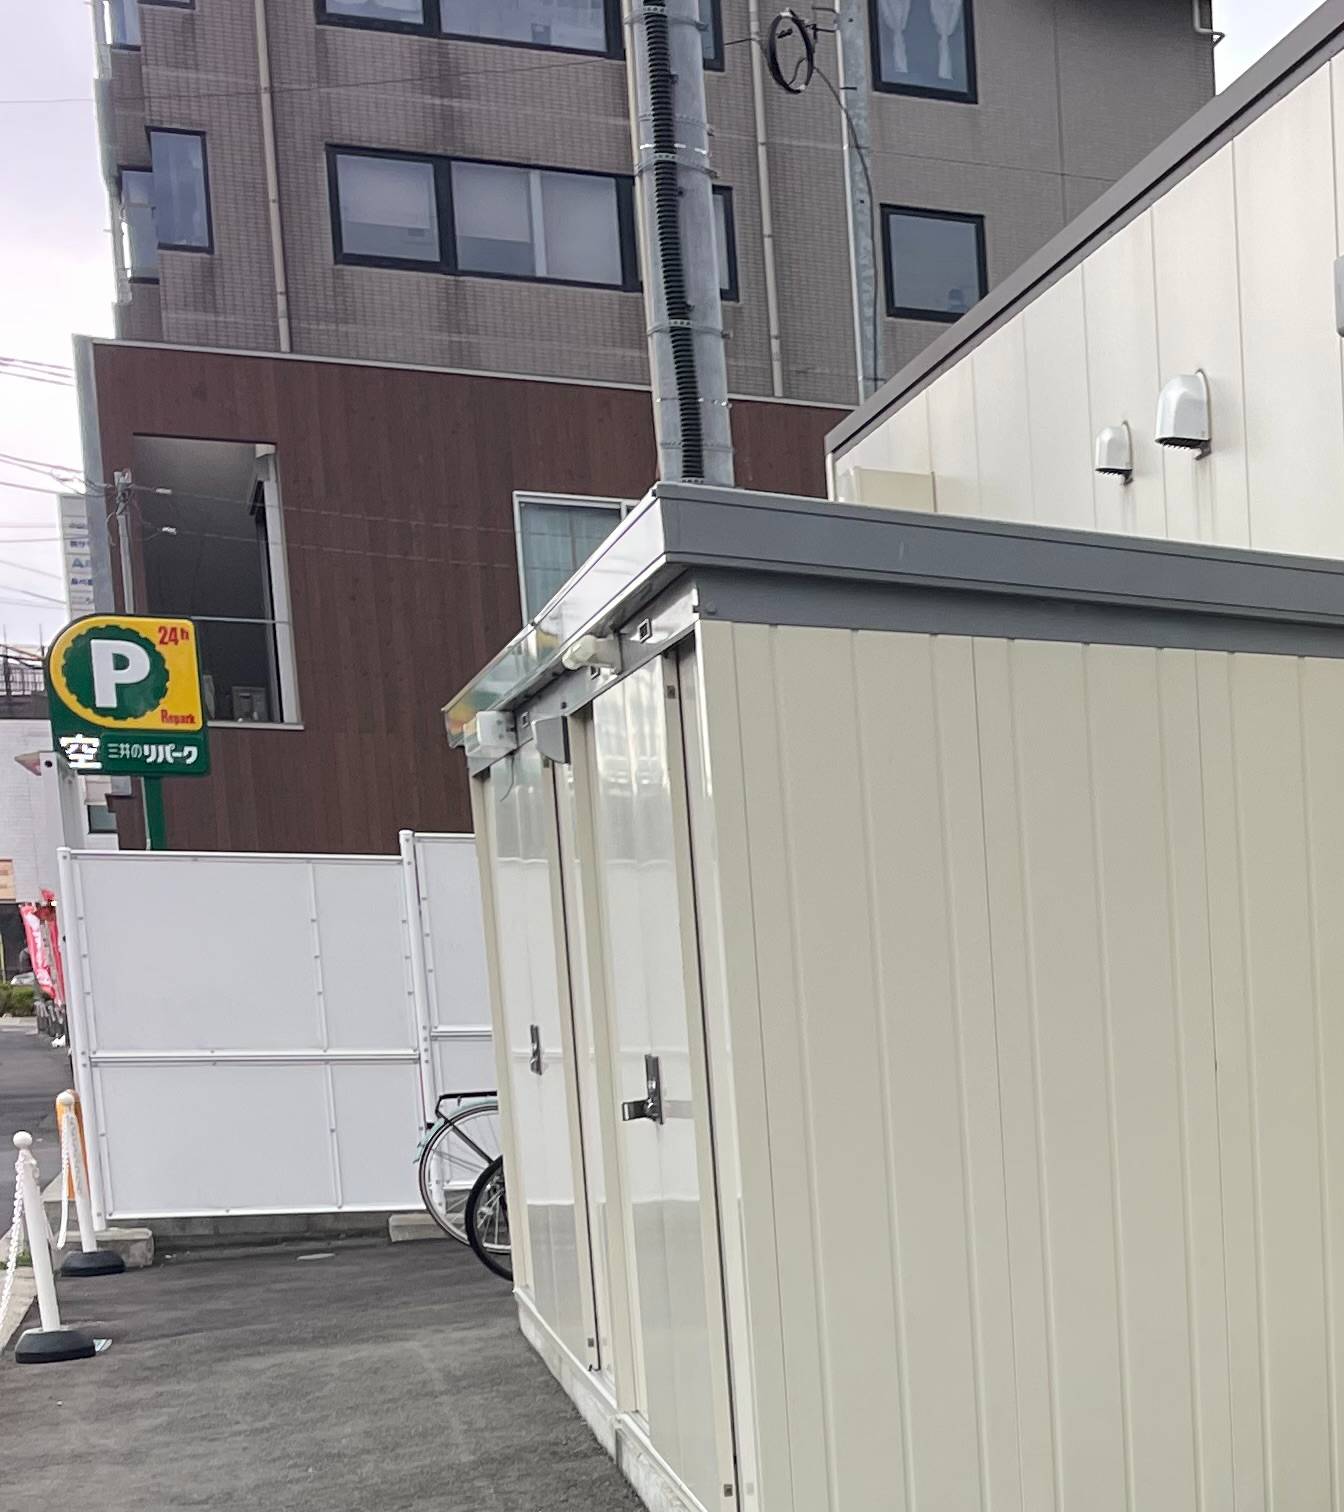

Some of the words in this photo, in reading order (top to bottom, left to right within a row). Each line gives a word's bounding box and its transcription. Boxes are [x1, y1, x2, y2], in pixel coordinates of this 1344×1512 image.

[90, 639, 150, 708] P
[59, 734, 102, 769] 空
[107, 742, 198, 765] 三井のリパーク
